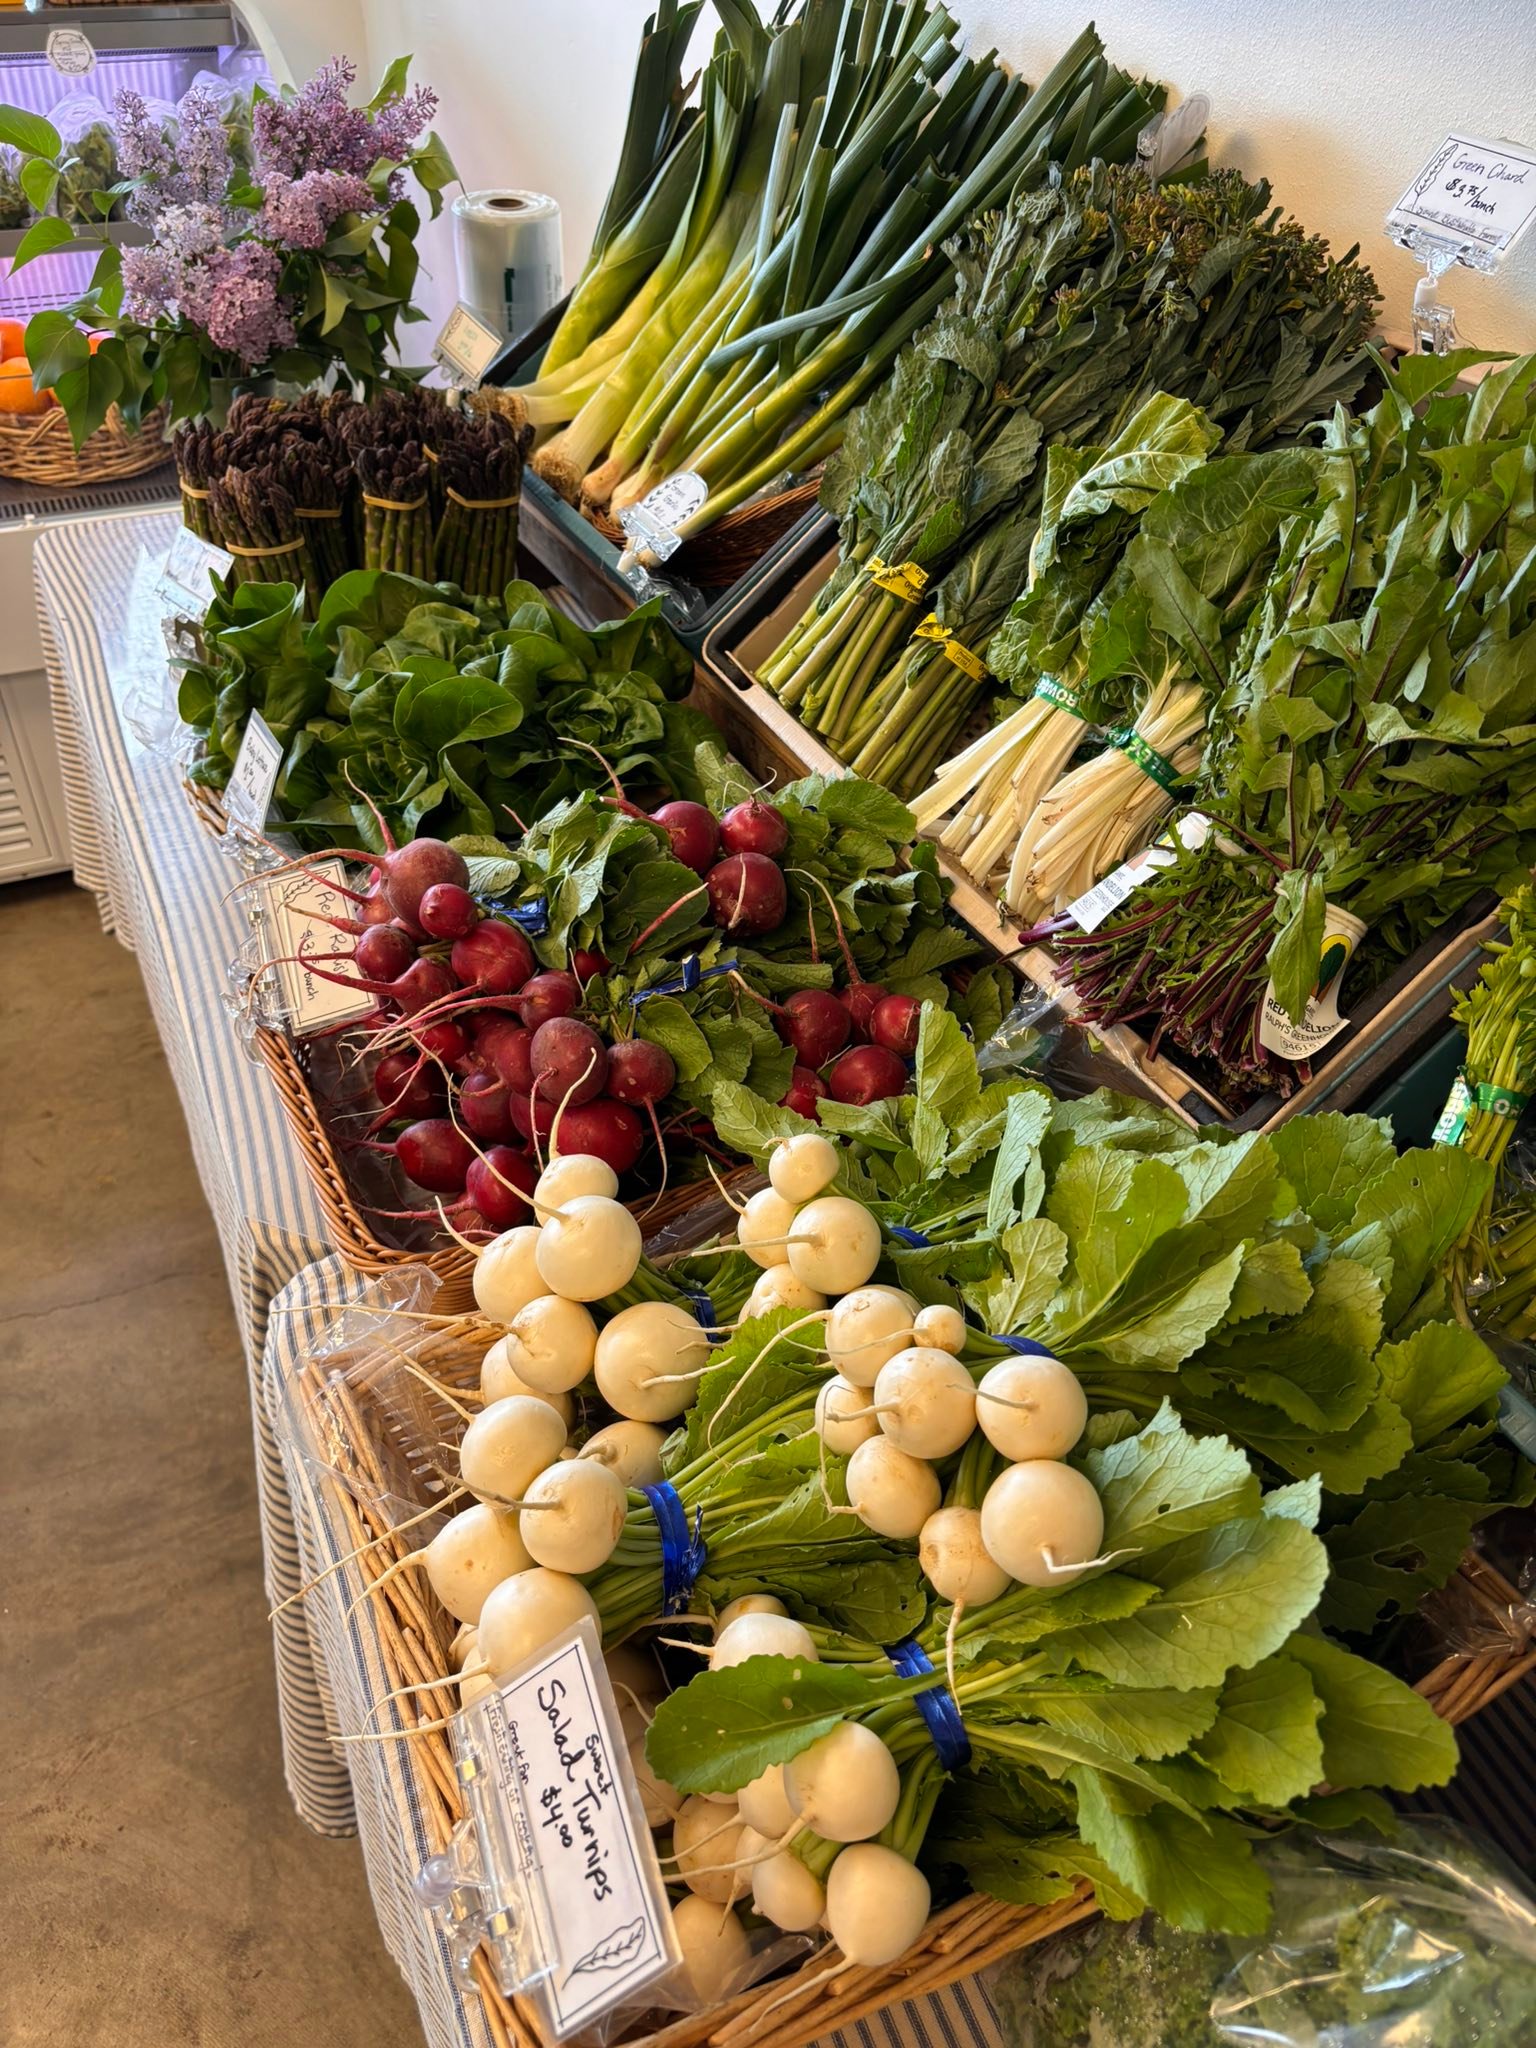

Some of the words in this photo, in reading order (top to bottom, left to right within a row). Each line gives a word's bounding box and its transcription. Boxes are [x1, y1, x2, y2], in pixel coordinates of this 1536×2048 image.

[1453, 153, 1485, 175] Green
[1487, 163, 1530, 184] Chard
[1264, 1011, 1291, 1035] RALPH'S
[1267, 997, 1286, 1016] RED
[507, 1720, 525, 1759] Great
[496, 1745, 515, 1790] eating
[508, 1788, 521, 1805] or
[584, 1733, 613, 1796] Sweet
[537, 1678, 586, 1783] Salad
[572, 1778, 613, 1902] Turnips
[540, 1785, 573, 1849] $4.00
